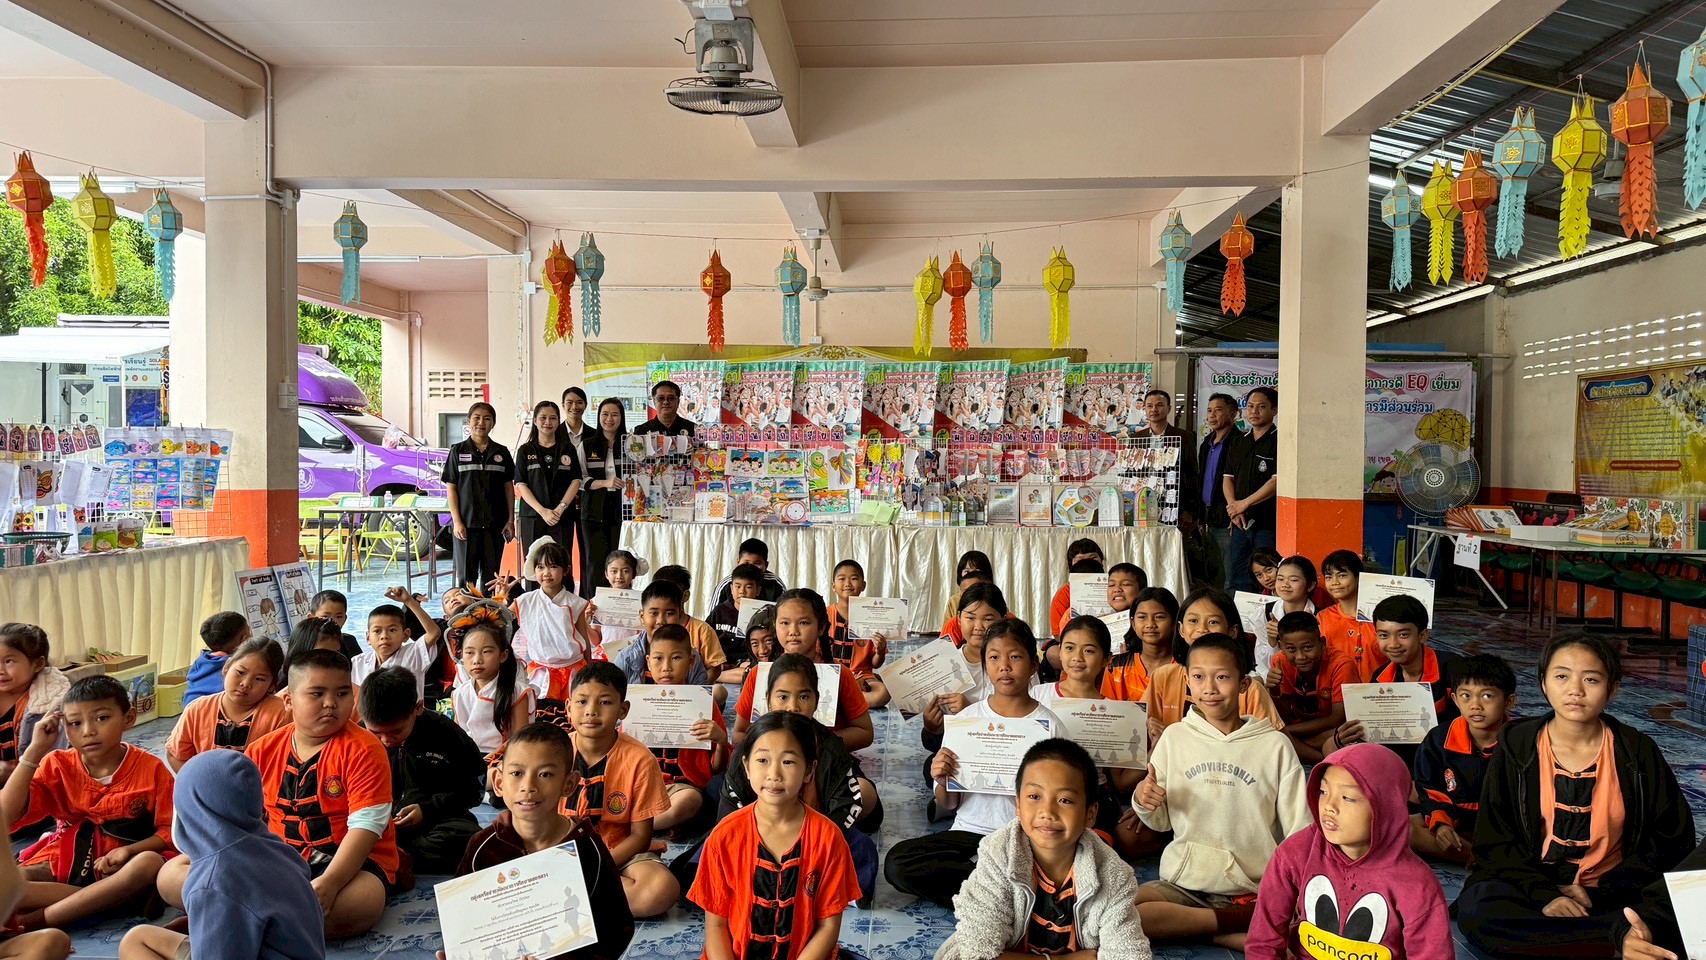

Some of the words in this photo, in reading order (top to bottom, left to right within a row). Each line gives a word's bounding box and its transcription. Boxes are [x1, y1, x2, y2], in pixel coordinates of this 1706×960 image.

[1407, 374, 1428, 392] EQ
[1431, 372, 1460, 390] เยี่ยม
[1456, 540, 1472, 554] ฐานที่
[1473, 545, 1478, 554] 2
[1185, 762, 1256, 786] GOODVIBESONLY
[1307, 934, 1379, 960] pancoat
